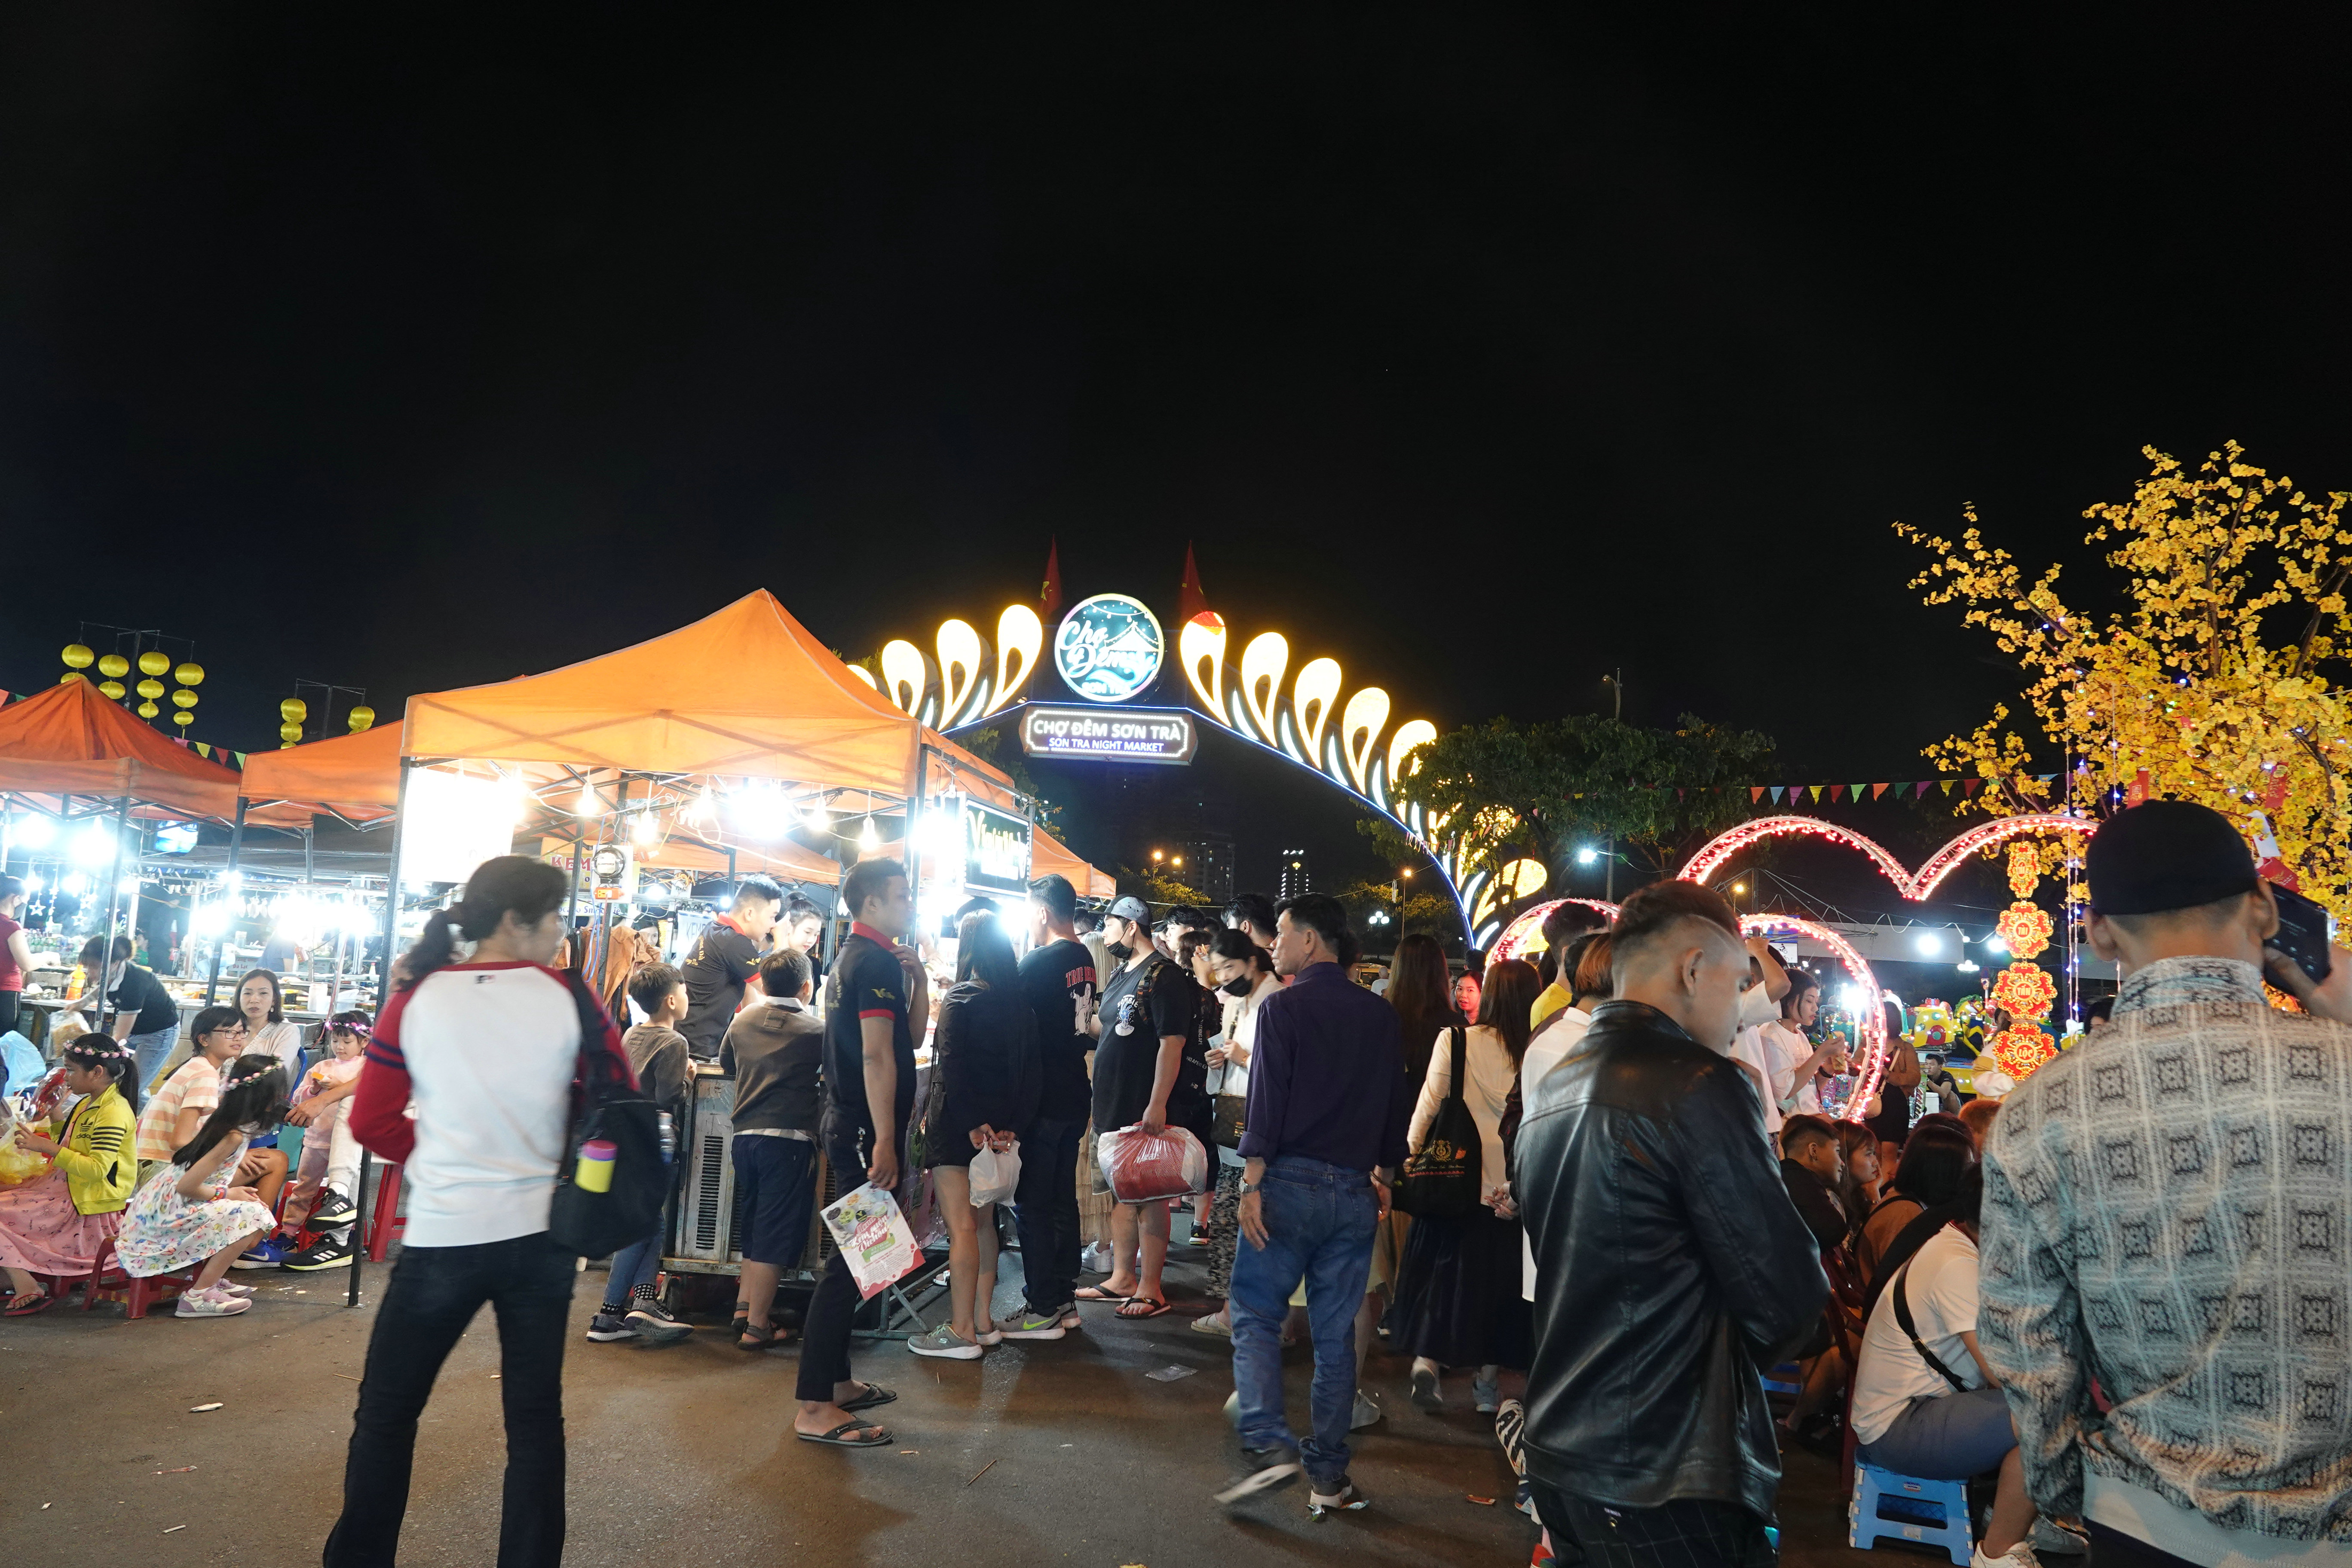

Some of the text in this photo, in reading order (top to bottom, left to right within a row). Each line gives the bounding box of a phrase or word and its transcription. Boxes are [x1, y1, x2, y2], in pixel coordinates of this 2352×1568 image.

[1033, 719, 1181, 741] CHỢ ĐÊM SƠN TRÀ
[1049, 738, 1164, 752] SON TRA NIGHT MARKET
[1066, 967, 1084, 988] TRUE
[2018, 1047, 2033, 1059] LỘC
